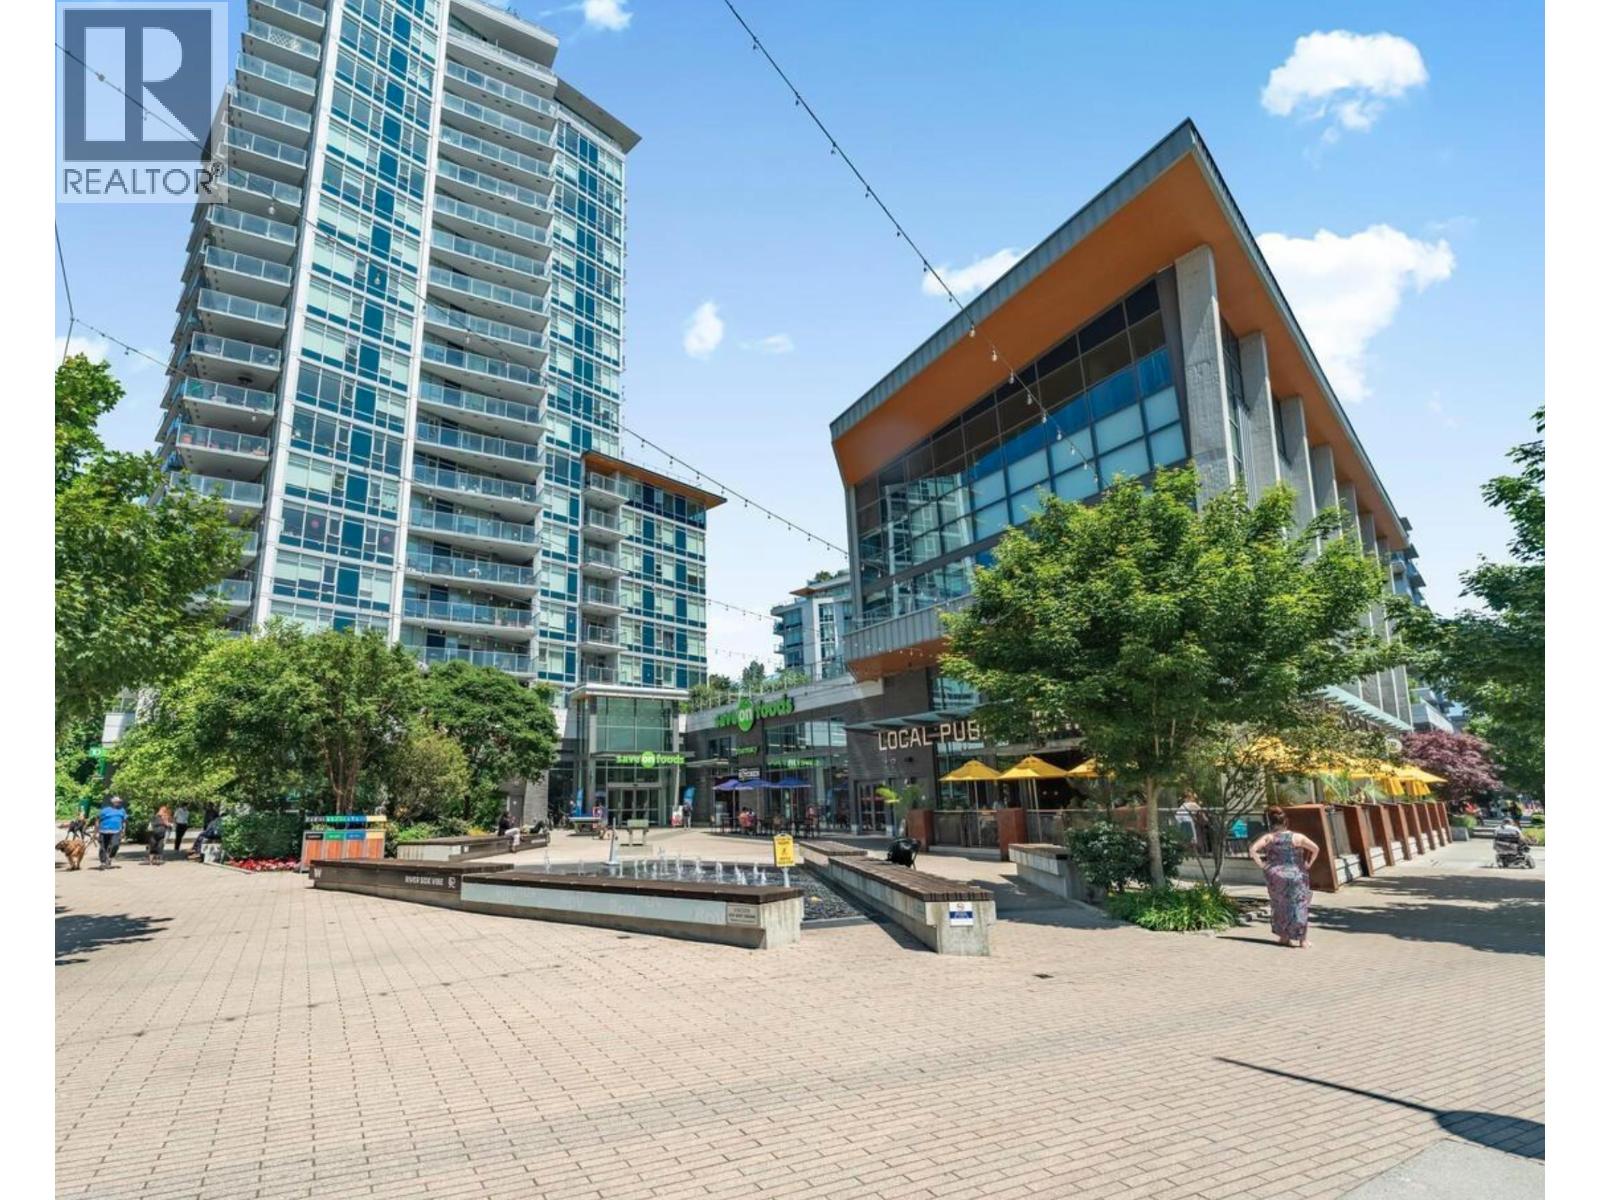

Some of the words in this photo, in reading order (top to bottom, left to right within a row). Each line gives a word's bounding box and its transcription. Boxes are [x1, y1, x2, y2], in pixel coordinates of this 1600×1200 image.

[755, 695, 792, 720] foods
[878, 726, 934, 751] LOCAL
[940, 719, 988, 744] PUB
[615, 755, 641, 764] save
[656, 754, 685, 765] foods
